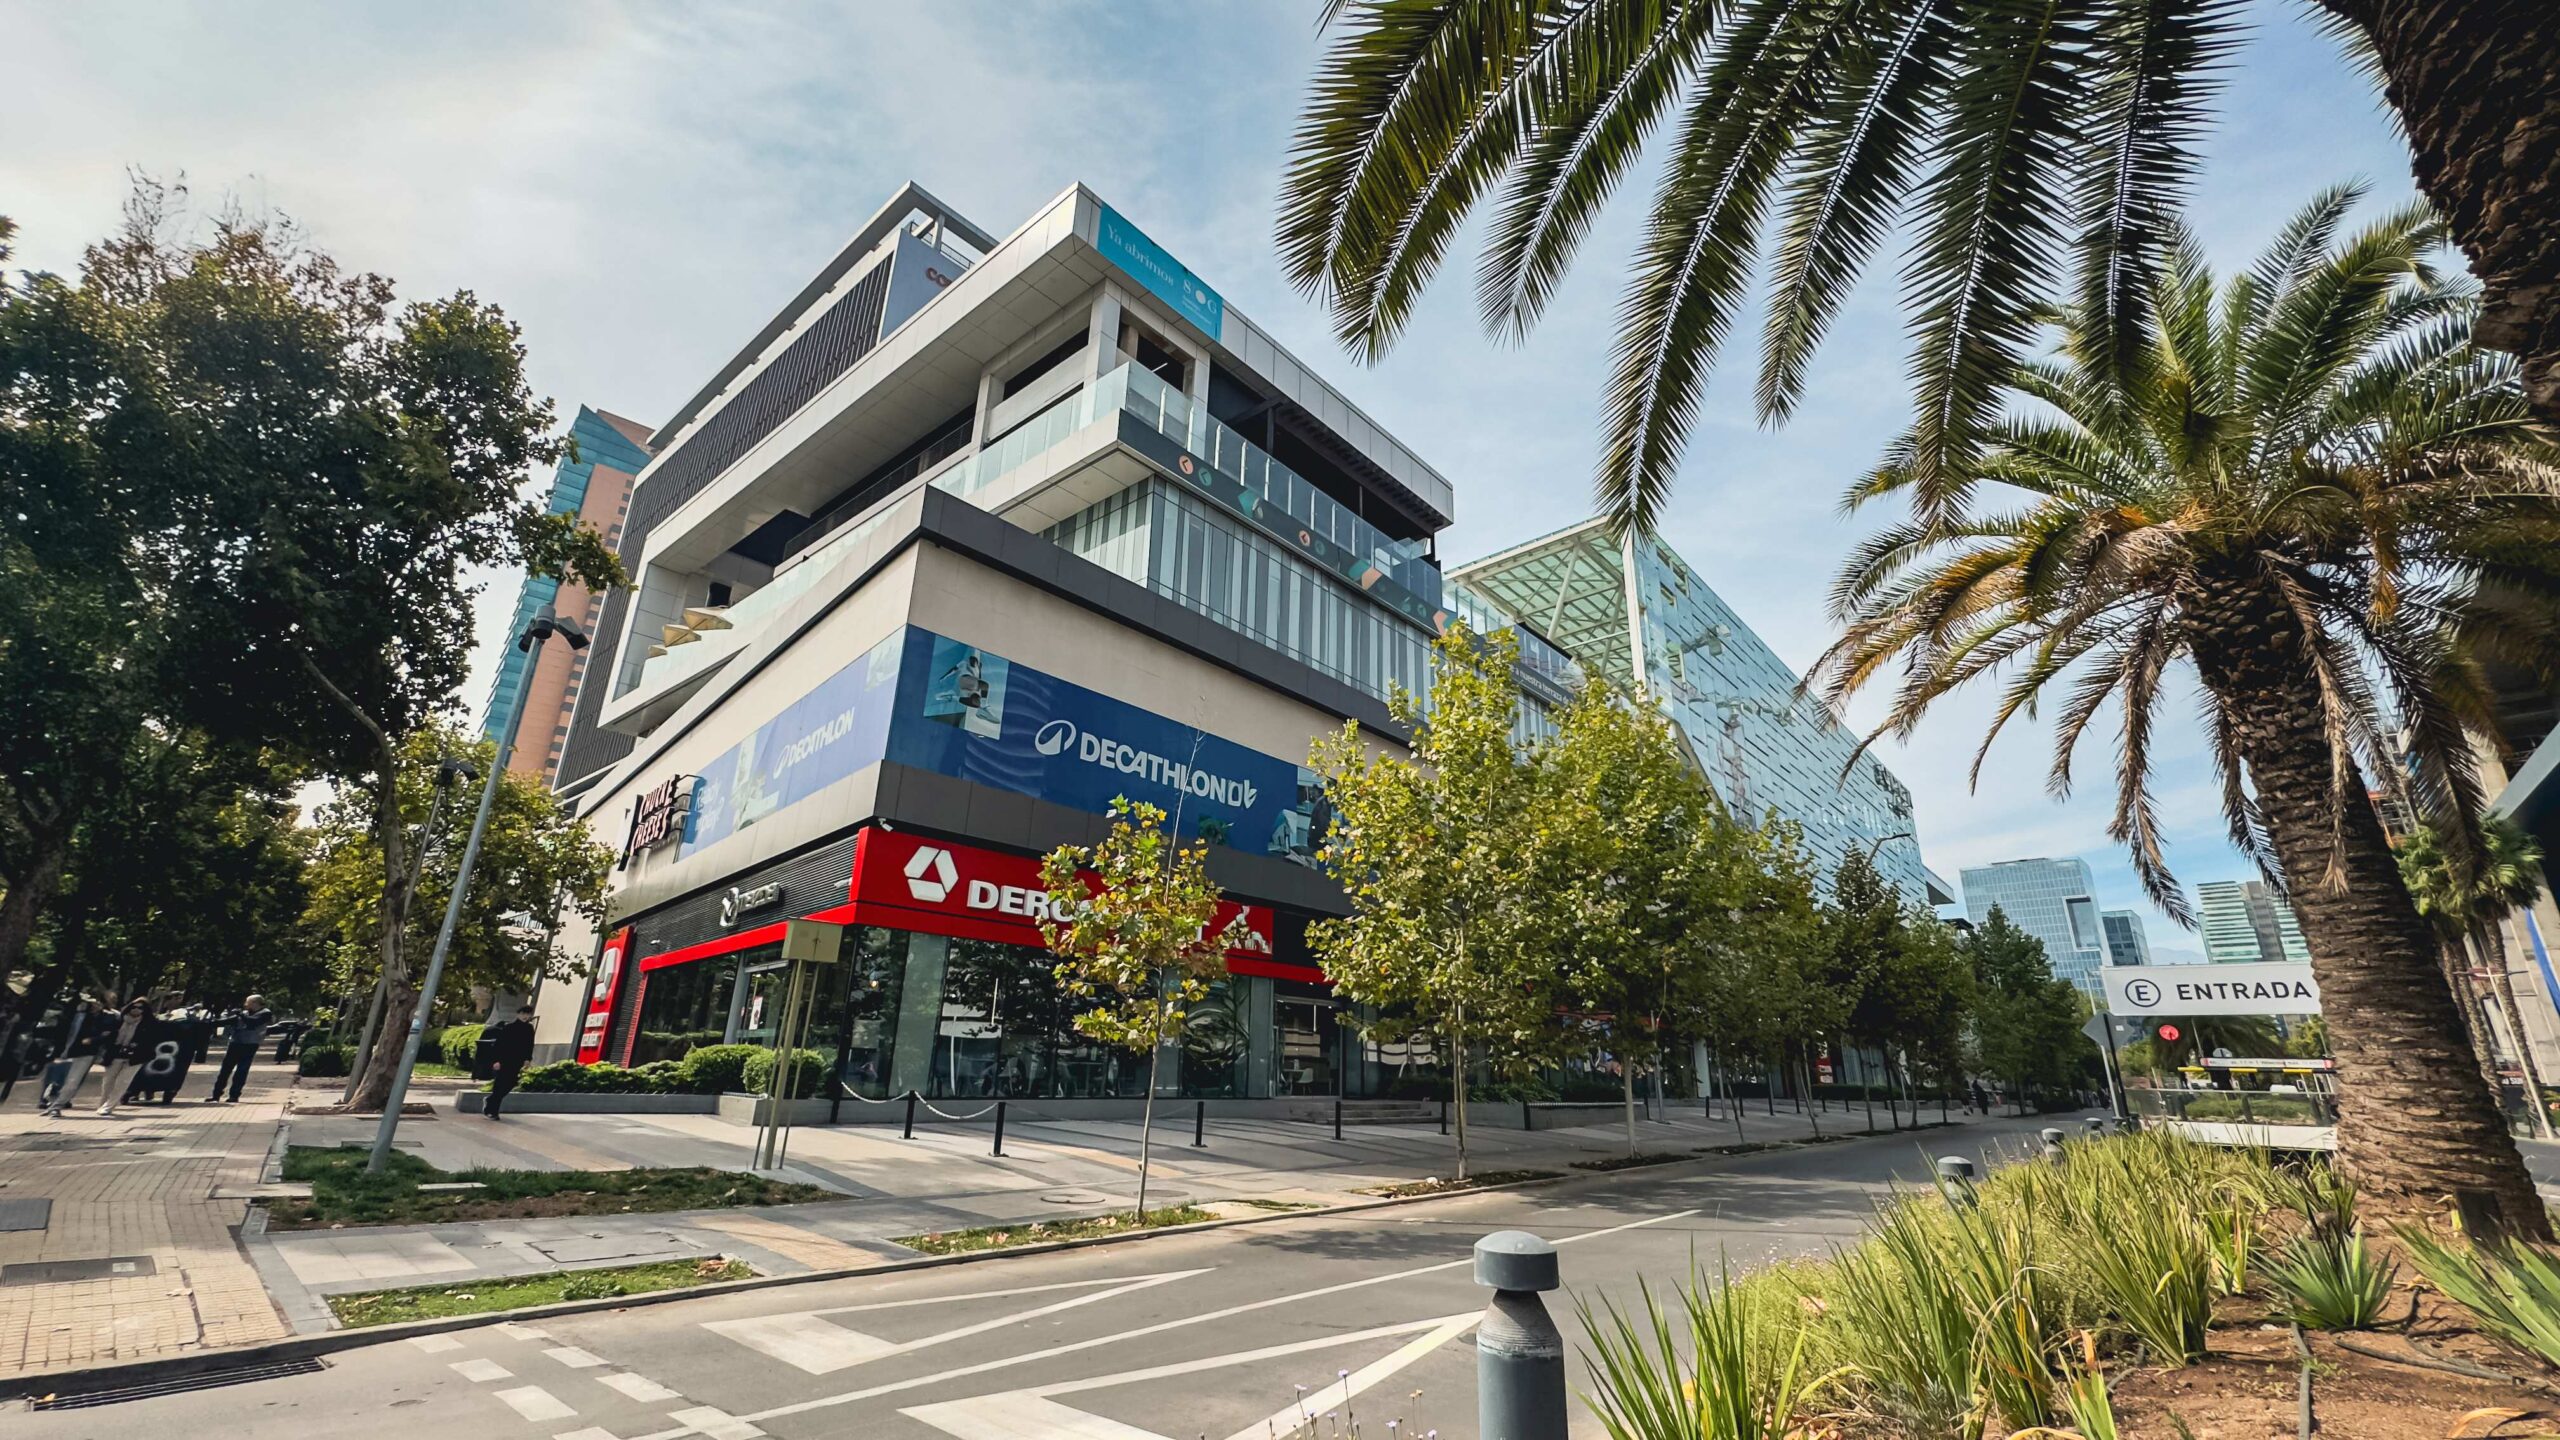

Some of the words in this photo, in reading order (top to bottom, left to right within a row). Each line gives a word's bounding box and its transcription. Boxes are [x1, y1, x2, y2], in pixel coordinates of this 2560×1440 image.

[1107, 223, 1121, 246] Ya
[787, 706, 855, 768] DECATHLON
[2134, 984, 2151, 1001] E
[2176, 981, 2312, 1001] ENTRADA
[145, 1041, 179, 1074] 8
